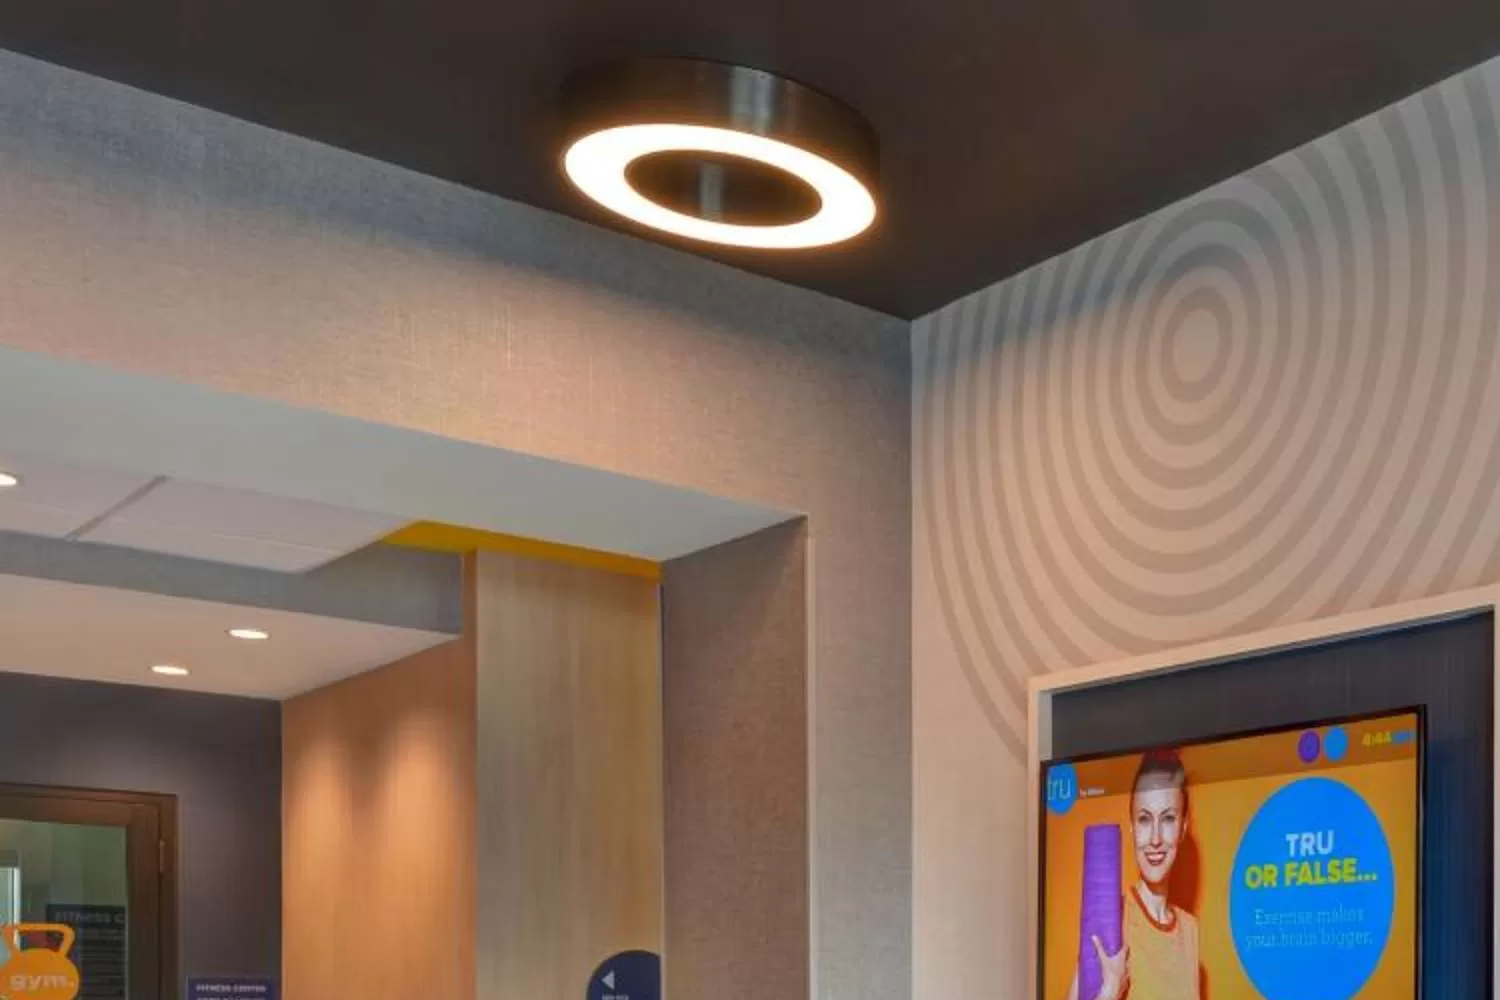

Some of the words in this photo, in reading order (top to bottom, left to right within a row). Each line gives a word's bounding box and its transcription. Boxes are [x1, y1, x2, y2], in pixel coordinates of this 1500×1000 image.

[1046, 775, 1071, 801] tru
[1285, 830, 1335, 857] TRU
[1245, 864, 1279, 889] OR
[1284, 857, 1378, 886] FALSE...
